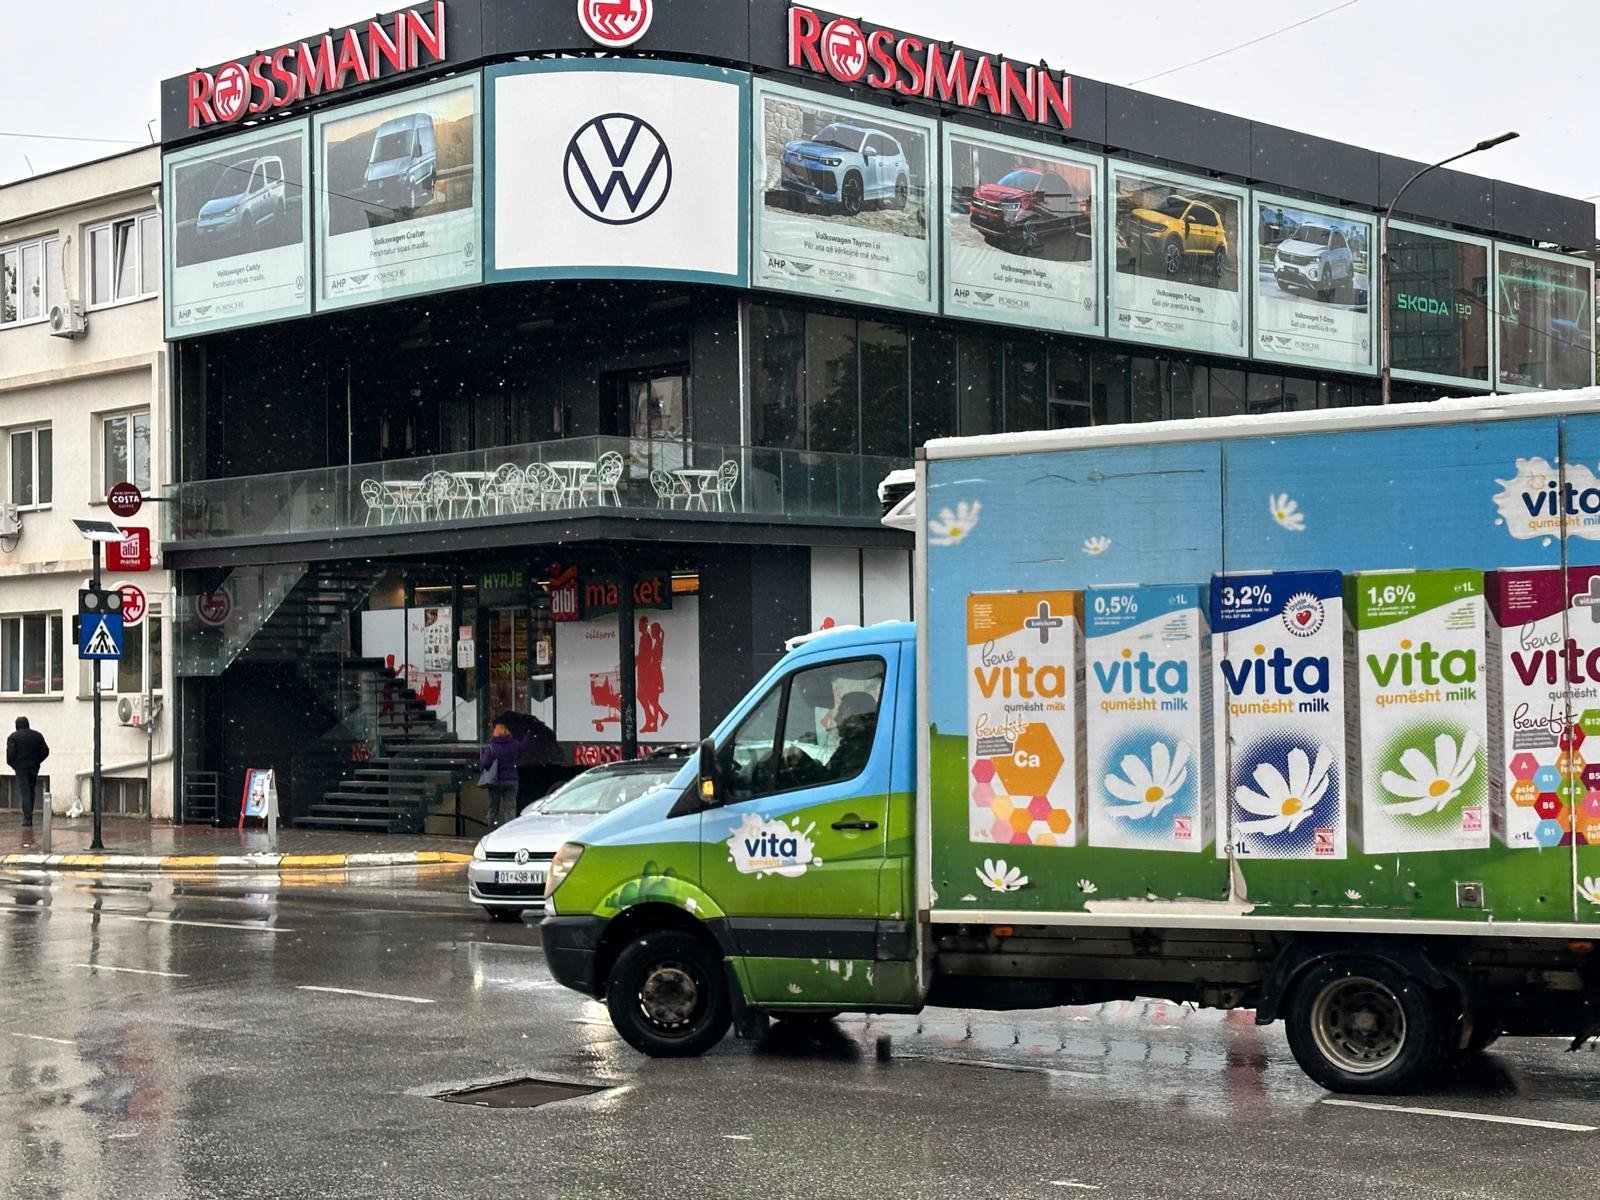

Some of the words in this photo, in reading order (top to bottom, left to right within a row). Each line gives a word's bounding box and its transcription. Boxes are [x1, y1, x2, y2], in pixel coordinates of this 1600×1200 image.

[188, 1, 446, 128] ROSSMANN
[788, 6, 1072, 129] ROSSMANN
[815, 231, 852, 245] Volkswagen
[768, 257, 786, 269] AHP
[331, 278, 346, 290] AHP
[954, 288, 970, 298] AHP
[178, 309, 192, 320] AHP
[1118, 313, 1132, 323] AHP
[1455, 303, 1472, 316] 130
[112, 495, 140, 504] COSTA
[122, 542, 138, 556] albi
[484, 571, 523, 590] HYRJE
[552, 587, 576, 614] albi
[1222, 585, 1272, 608] 3,2%
[1367, 584, 1416, 606] 1,6%
[1094, 595, 1138, 616] 0,5%
[1520, 620, 1561, 651] bene
[982, 640, 1016, 667] bene
[1093, 648, 1188, 694] vita
[1220, 644, 1330, 696] vita
[1366, 639, 1476, 688] vita
[974, 656, 1066, 699] vita
[1101, 698, 1157, 713] qumësht
[1161, 698, 1188, 711] milk
[1376, 689, 1441, 708] qumësht
[1446, 687, 1477, 701] milk
[1004, 702, 1044, 713] qumësht
[1046, 702, 1066, 711] milk
[1230, 699, 1294, 717] qumësht
[1299, 698, 1330, 713] milk
[1513, 703, 1578, 734] benefit
[1014, 750, 1040, 767] Ca
[1516, 785, 1535, 793] acid
[1563, 787, 1581, 795] B2
[1543, 802, 1554, 810] B6
[745, 831, 797, 857] vita
